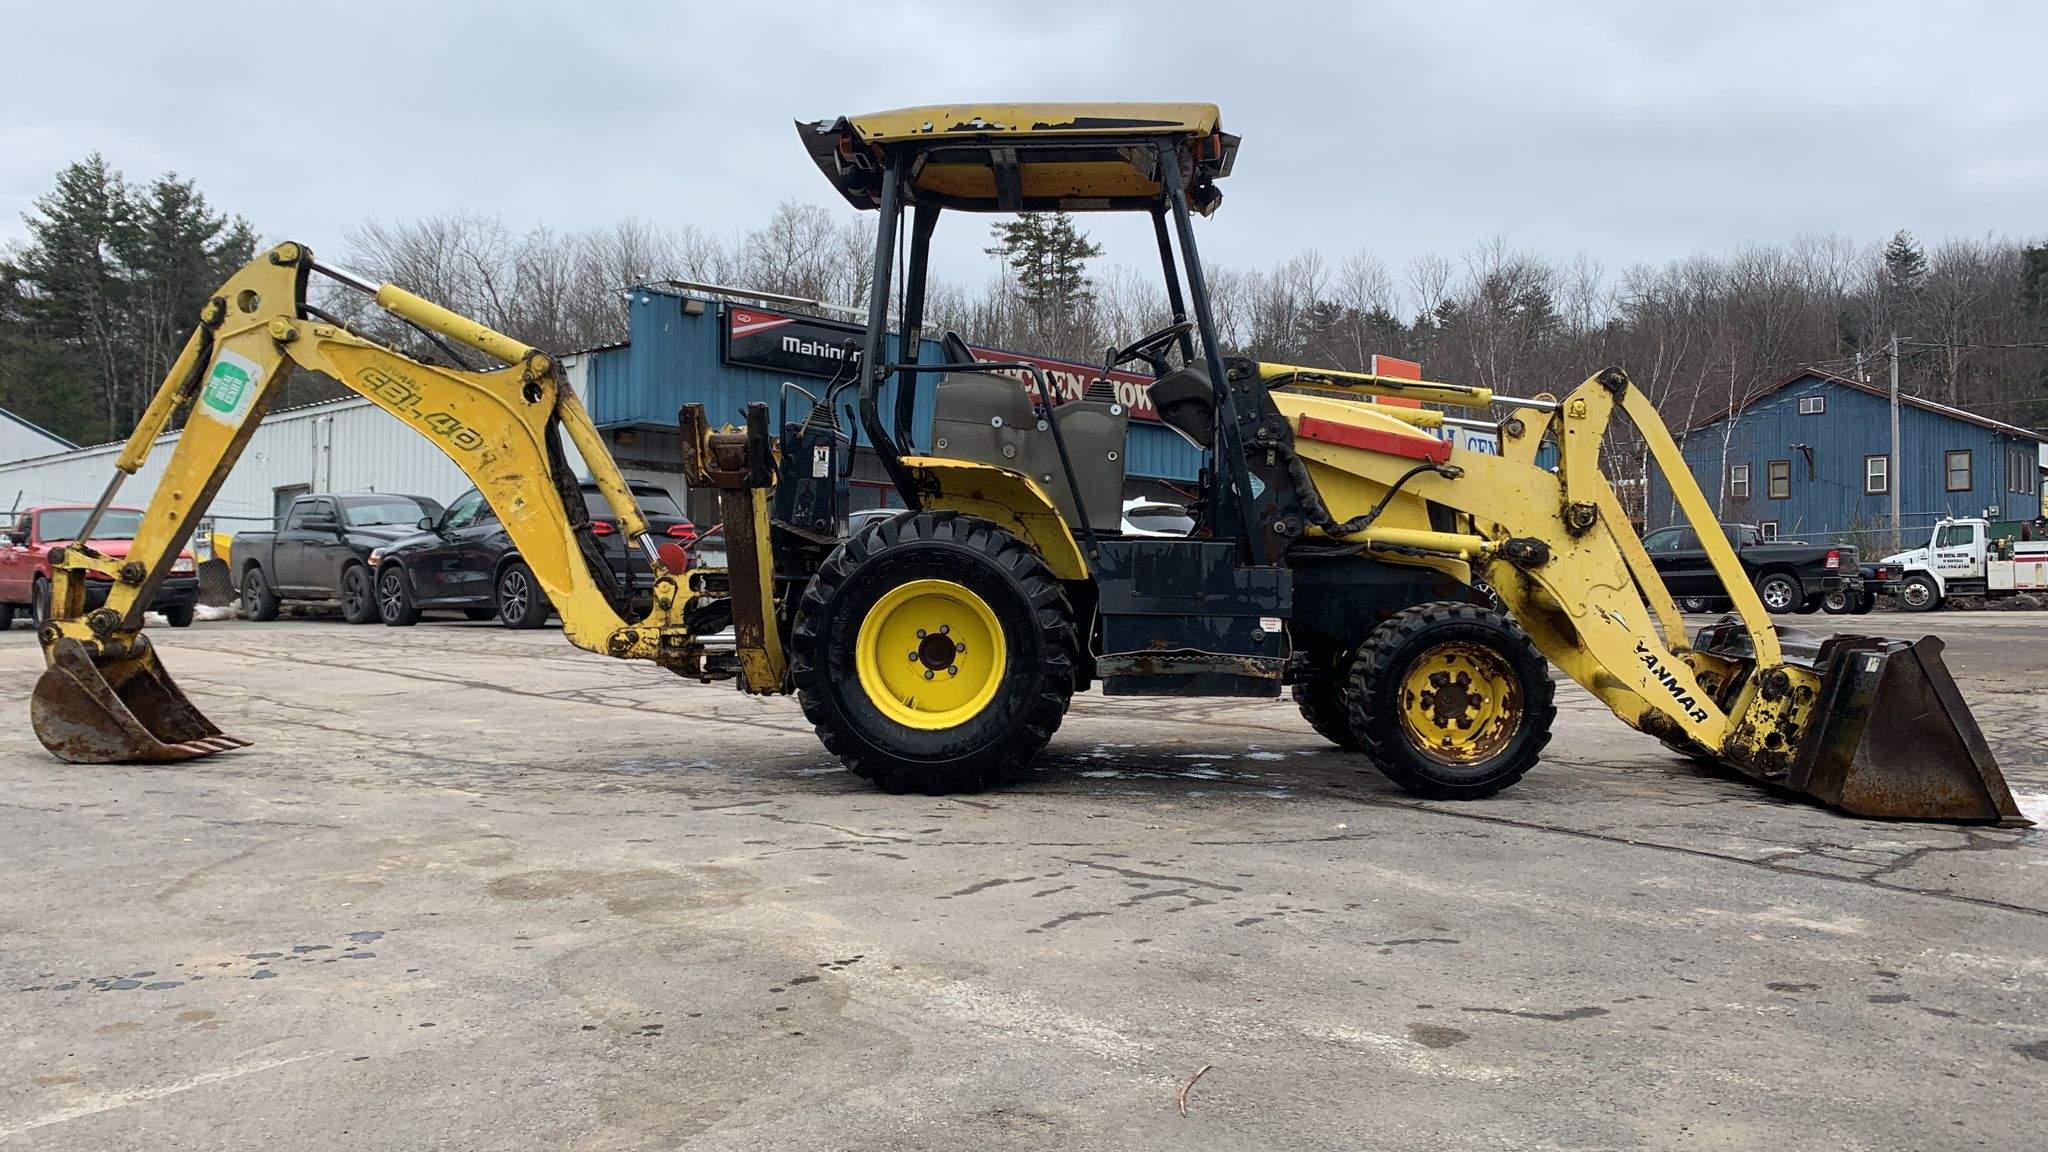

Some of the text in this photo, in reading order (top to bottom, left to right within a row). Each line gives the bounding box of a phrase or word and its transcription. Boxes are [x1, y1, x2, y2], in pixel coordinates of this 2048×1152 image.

[782, 336, 862, 362] Mahinr
[208, 375, 222, 390] THE
[215, 374, 234, 401] RENTAL
[1632, 640, 1709, 724] YANMAR
